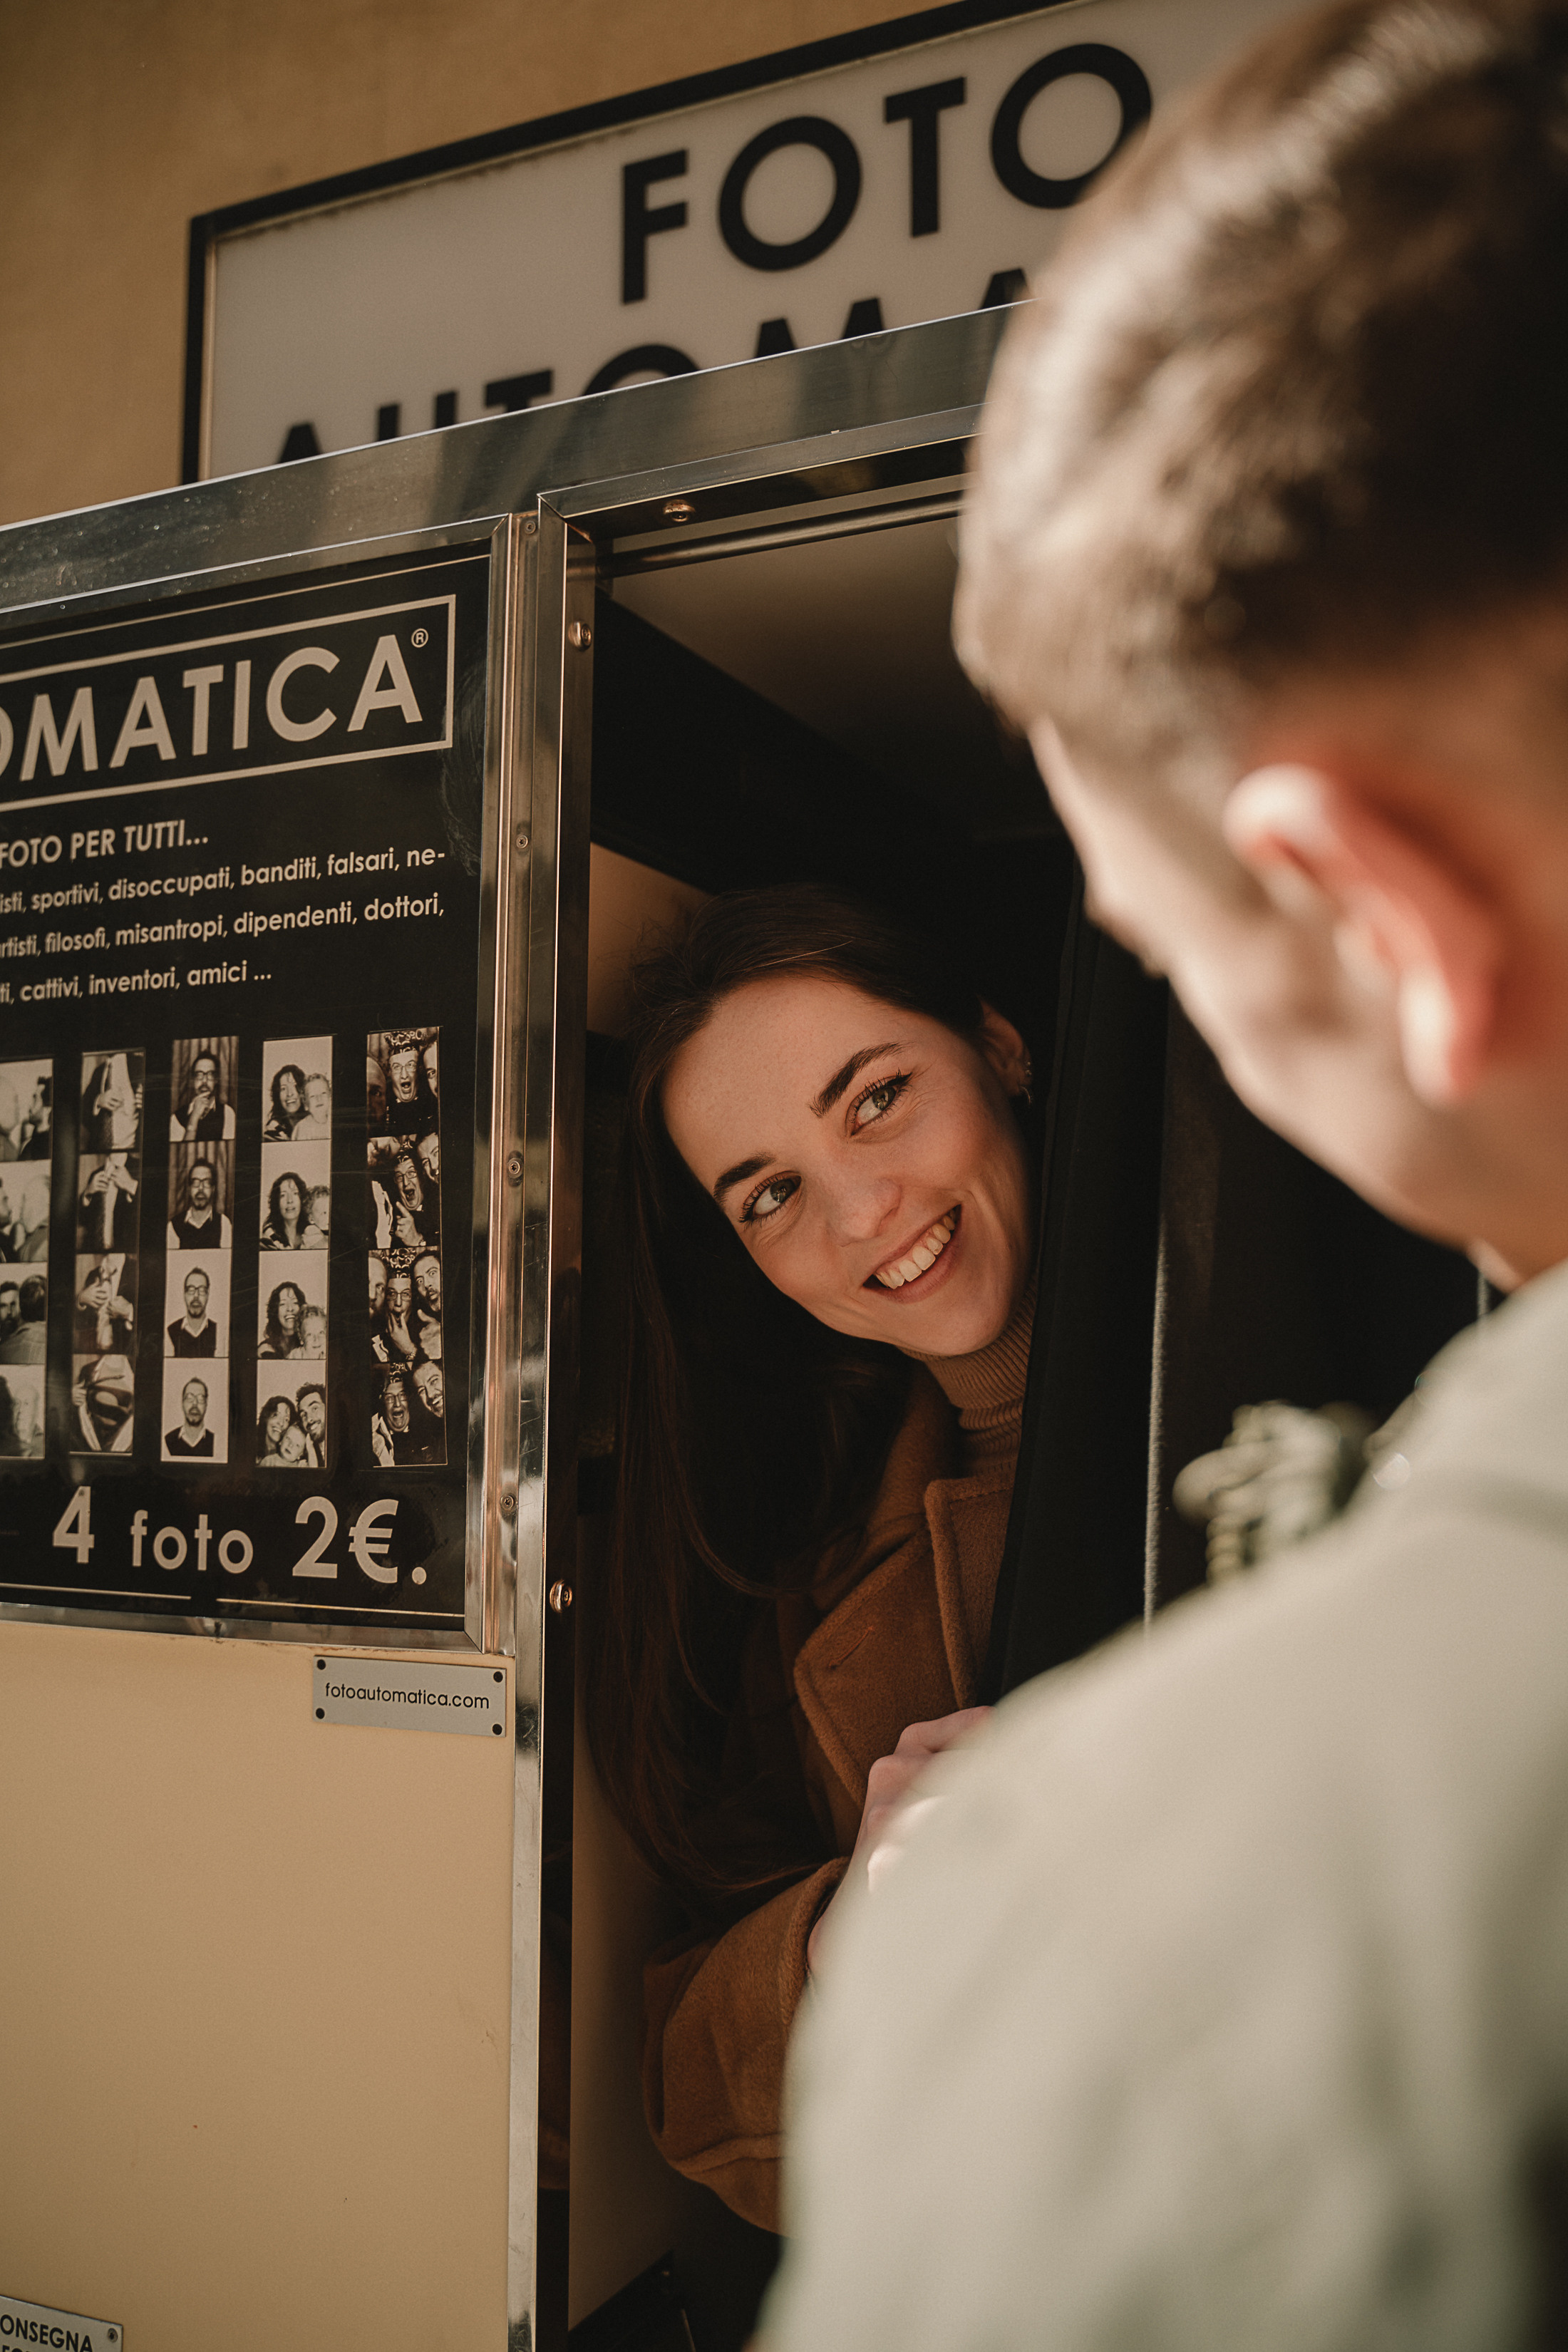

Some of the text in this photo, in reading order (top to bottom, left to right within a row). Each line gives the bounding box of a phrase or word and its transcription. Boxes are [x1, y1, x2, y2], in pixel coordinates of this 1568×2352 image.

[621, 43, 1152, 305] FOTO
[0, 819, 208, 869] FOTO PER TUTTI...
[31, 882, 103, 914] sportivi,
[108, 866, 234, 900] disoccupati,
[241, 856, 321, 886] banditi,
[327, 847, 399, 876] falsari,
[406, 848, 445, 867] ne-
[45, 927, 110, 954] filosofi,
[115, 914, 227, 946] misantropi,
[233, 901, 358, 937] dipendenti,
[364, 892, 443, 922] dottori,
[20, 976, 83, 1002] cattivi,
[88, 966, 180, 996] inventori,
[187, 960, 247, 986] amici
[53, 1486, 94, 1564] 4
[130, 1510, 254, 1574] foto
[325, 1682, 490, 1709] fotoautomatica.com
[0, 2314, 93, 2352] ONSEGNA
